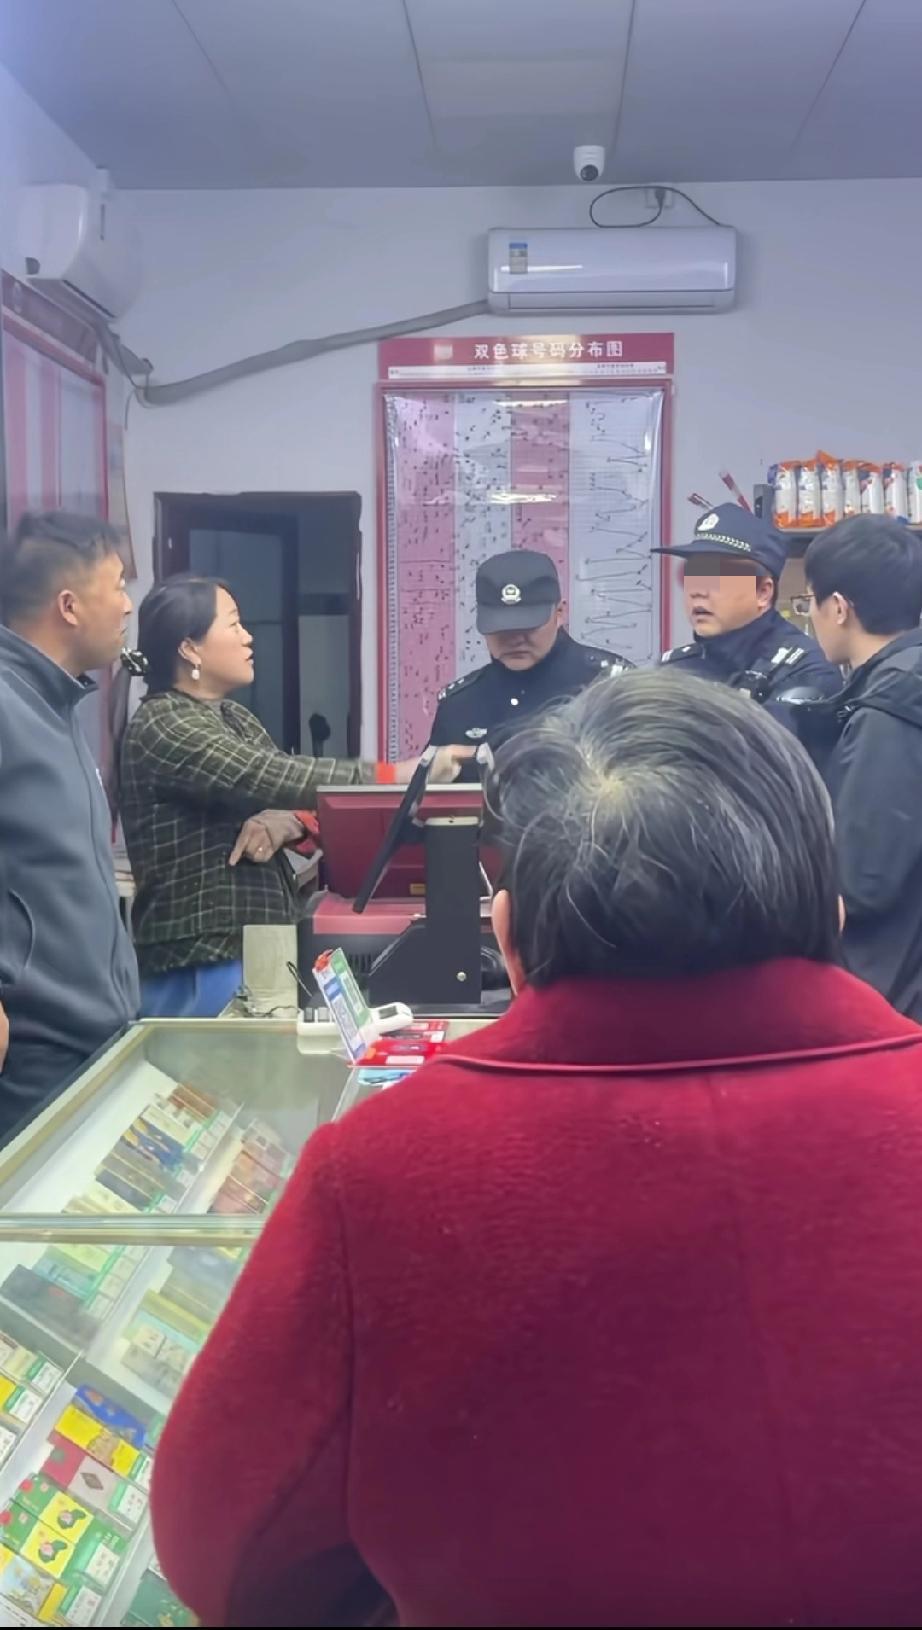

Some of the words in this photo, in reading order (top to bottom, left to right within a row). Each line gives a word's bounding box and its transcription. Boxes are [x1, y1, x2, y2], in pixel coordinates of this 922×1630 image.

[474, 341, 623, 360] 双色球号码分布图
